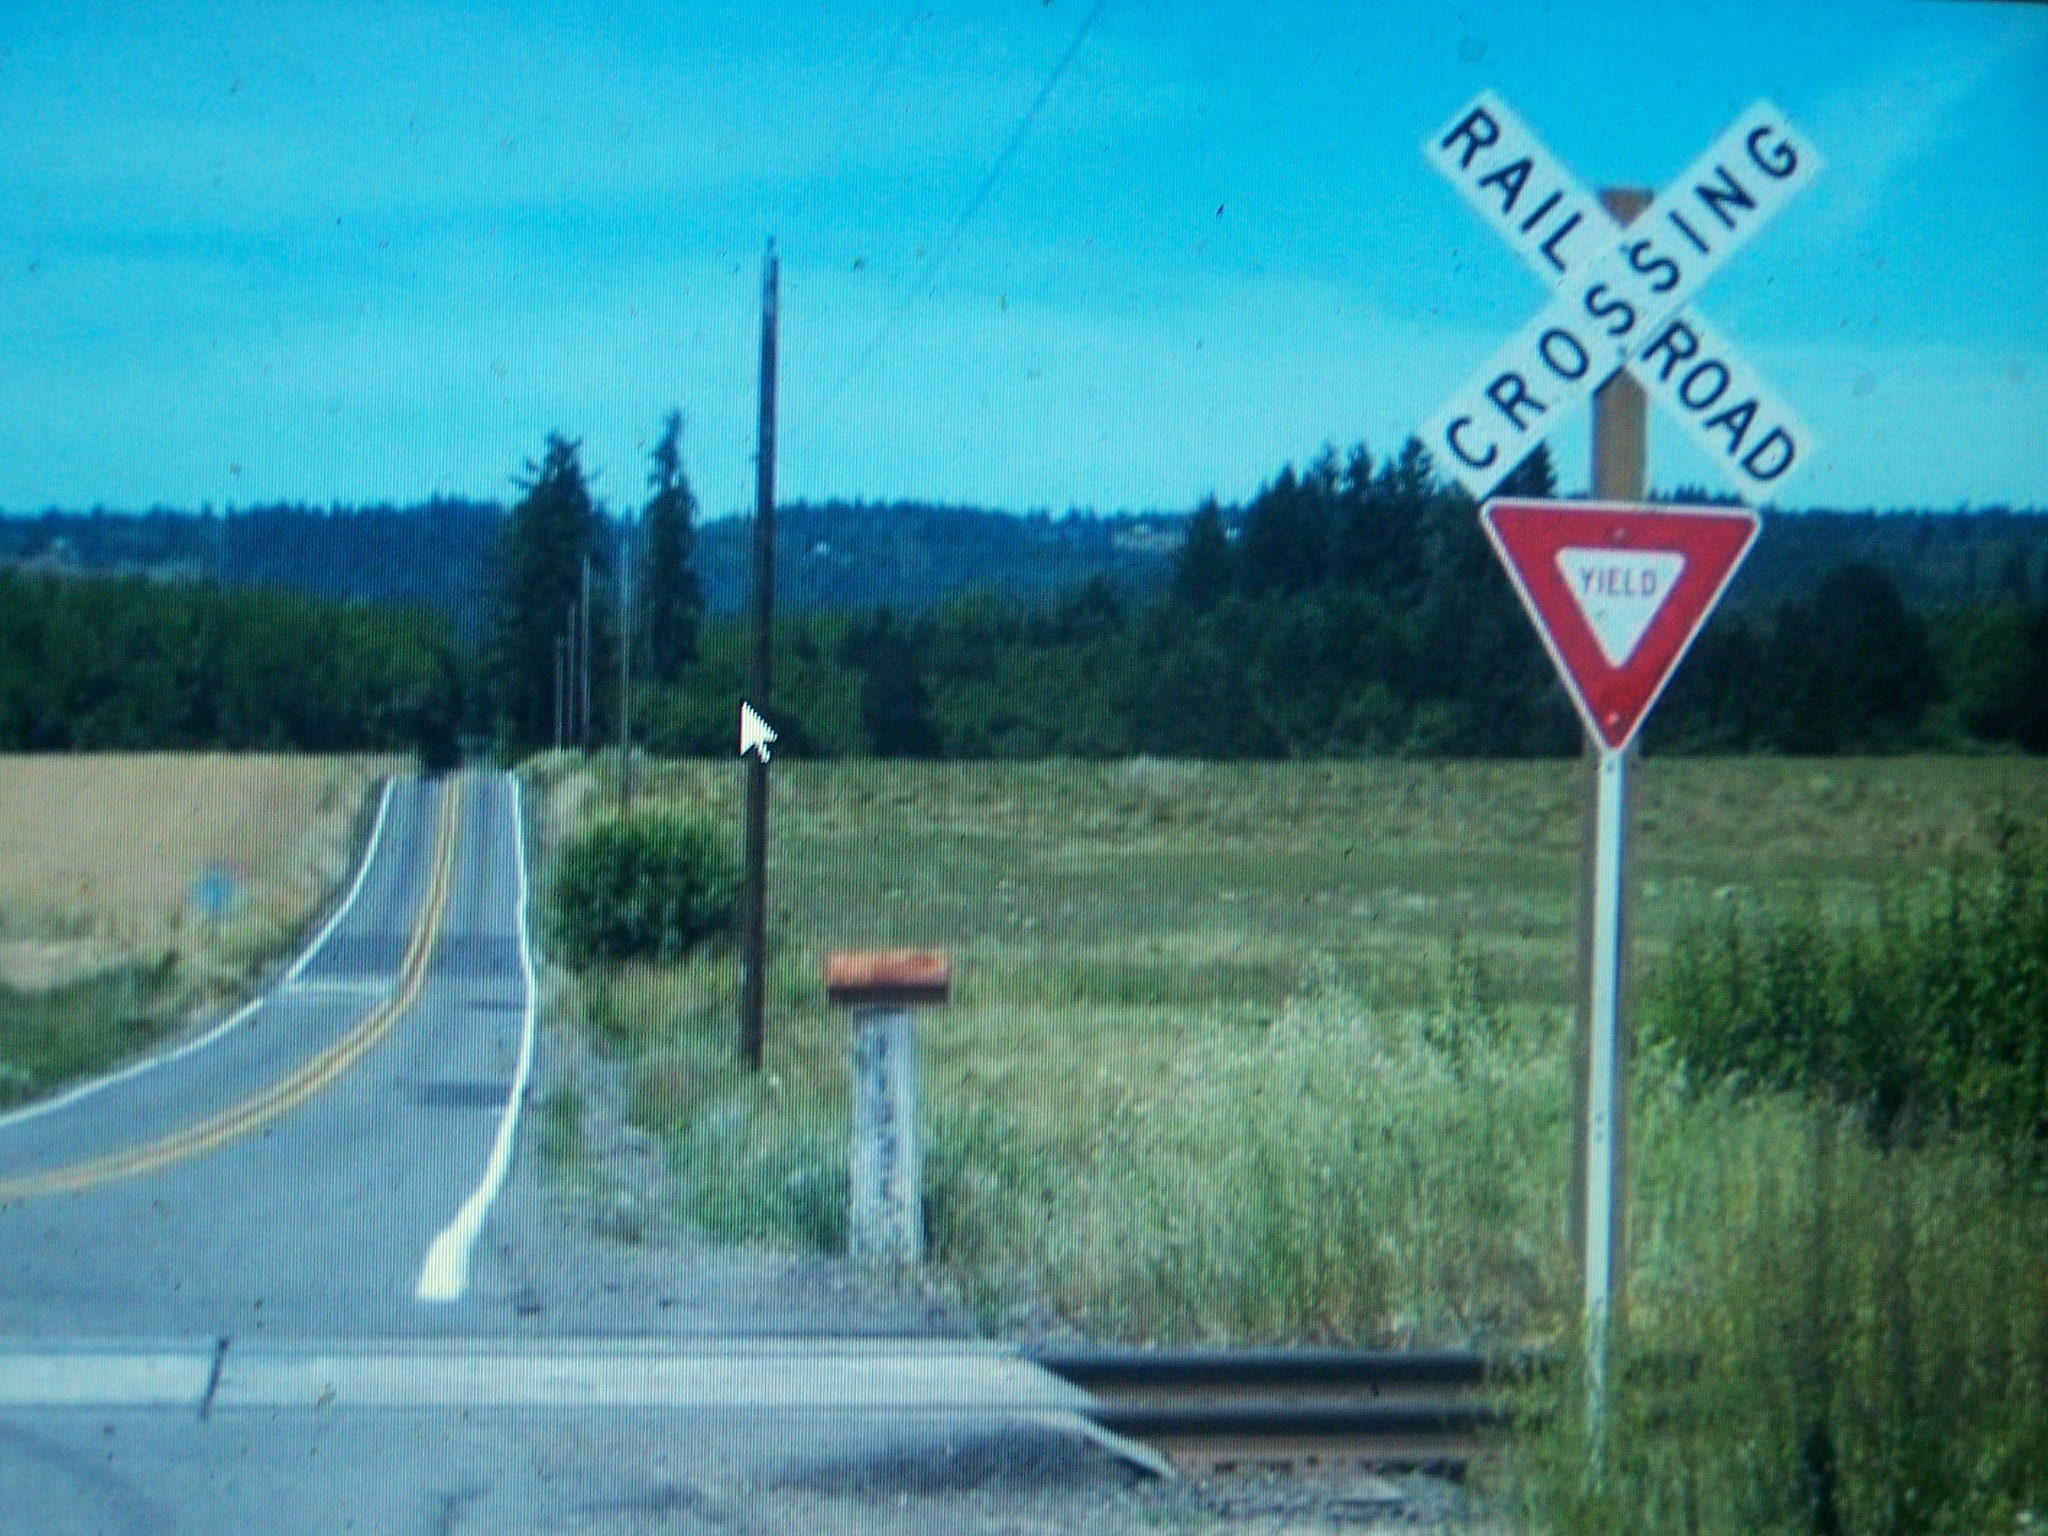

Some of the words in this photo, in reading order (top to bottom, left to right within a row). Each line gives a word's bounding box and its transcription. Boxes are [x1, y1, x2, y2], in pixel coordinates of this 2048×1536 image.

[1441, 106, 1583, 274] RAIL
[1641, 319, 1797, 481] ROAD
[1446, 126, 1798, 470] CROSSING
[1582, 568, 1657, 597] YIELD
